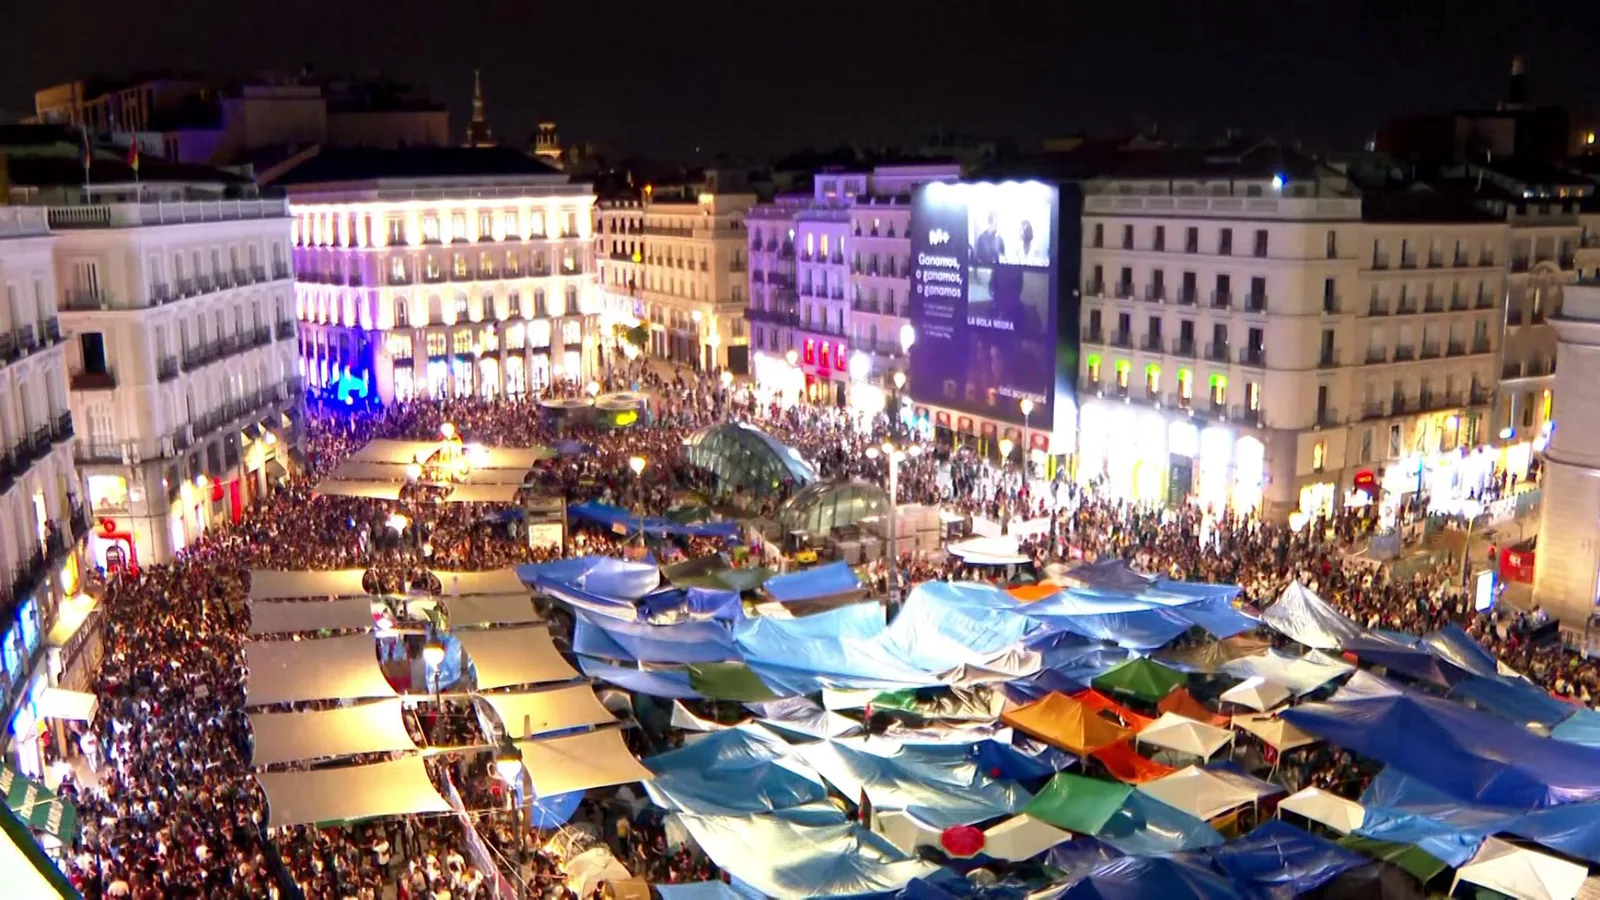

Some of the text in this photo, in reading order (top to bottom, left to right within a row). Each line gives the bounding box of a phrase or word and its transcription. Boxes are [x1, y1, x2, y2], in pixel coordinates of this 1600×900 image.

[918, 253, 960, 270] Ganamos,
[916, 270, 963, 286] o ganamos,
[917, 284, 961, 298] o ganamos
